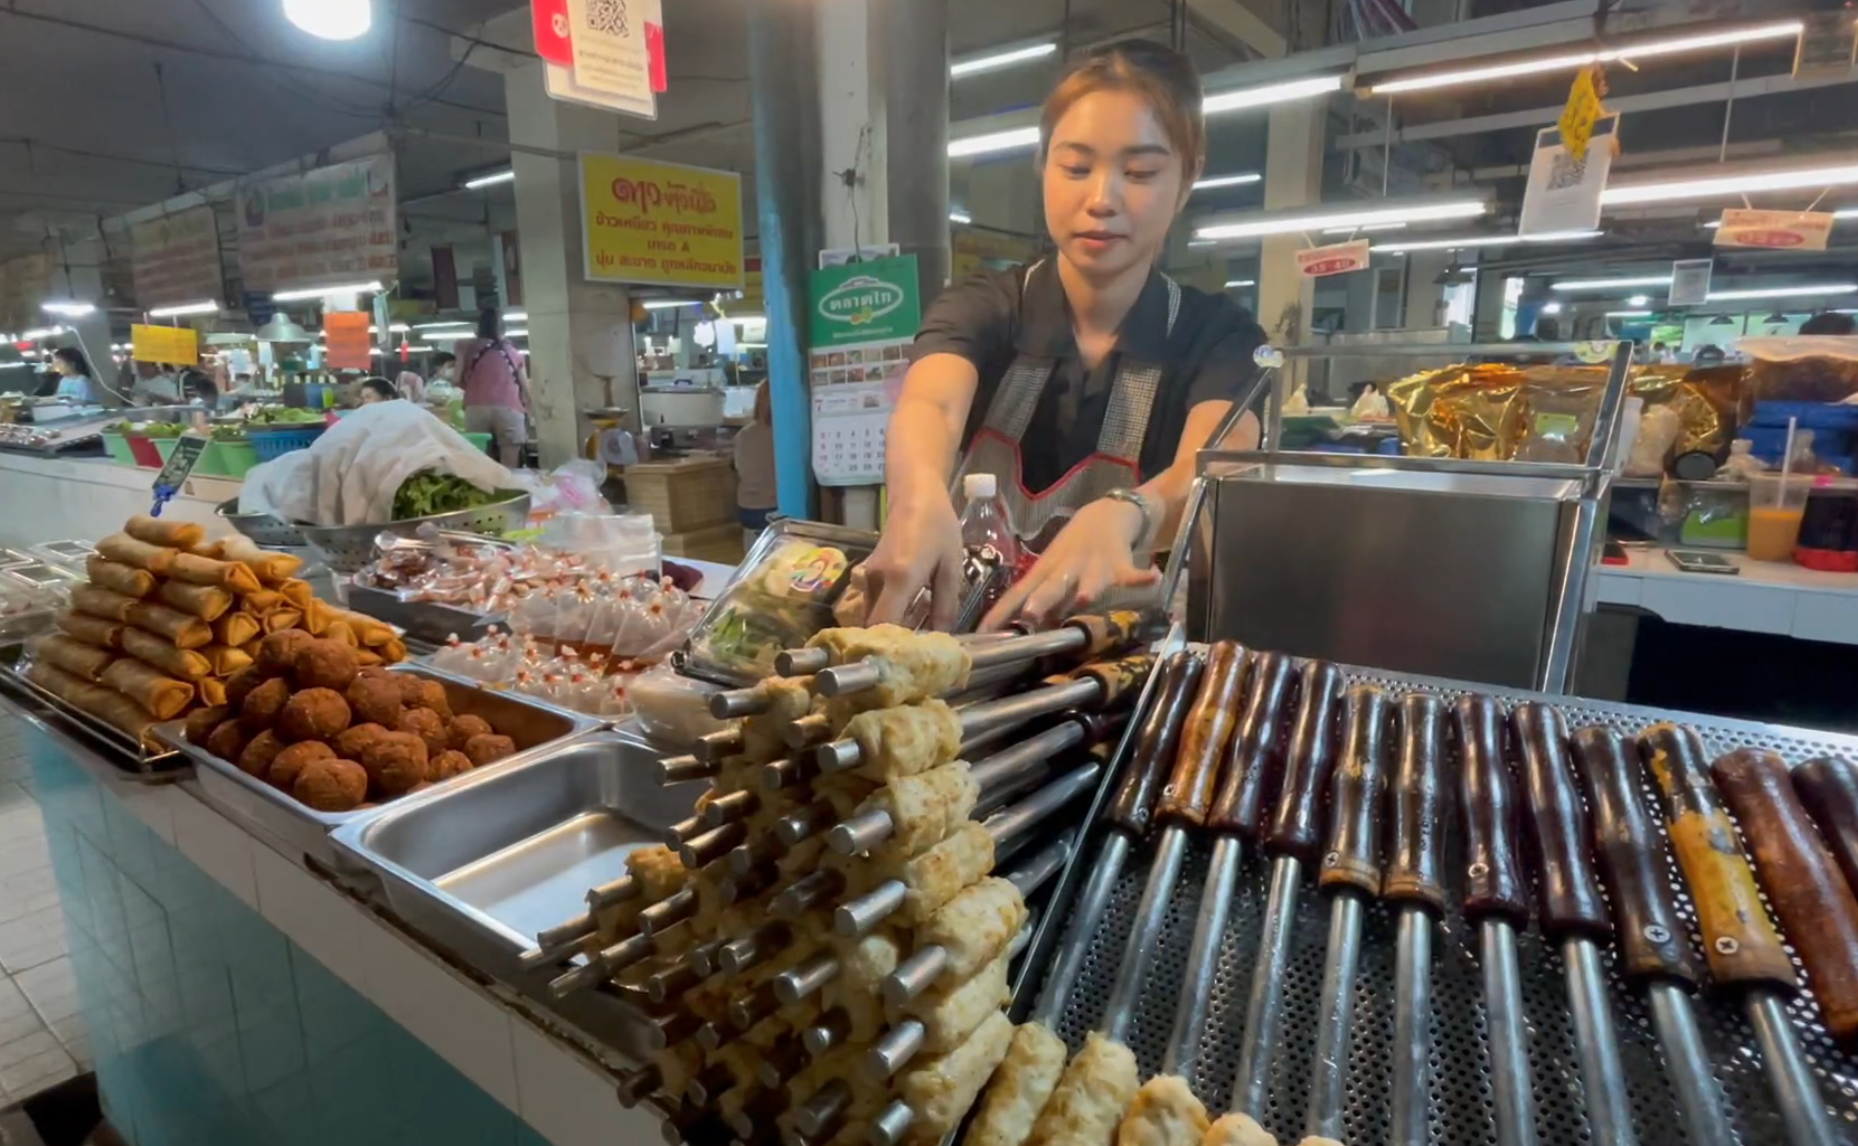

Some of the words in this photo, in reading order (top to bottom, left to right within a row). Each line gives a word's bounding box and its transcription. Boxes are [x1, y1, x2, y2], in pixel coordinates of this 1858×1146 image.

[595, 210, 657, 231] ข้าวเหนียว
[681, 240, 690, 252] A
